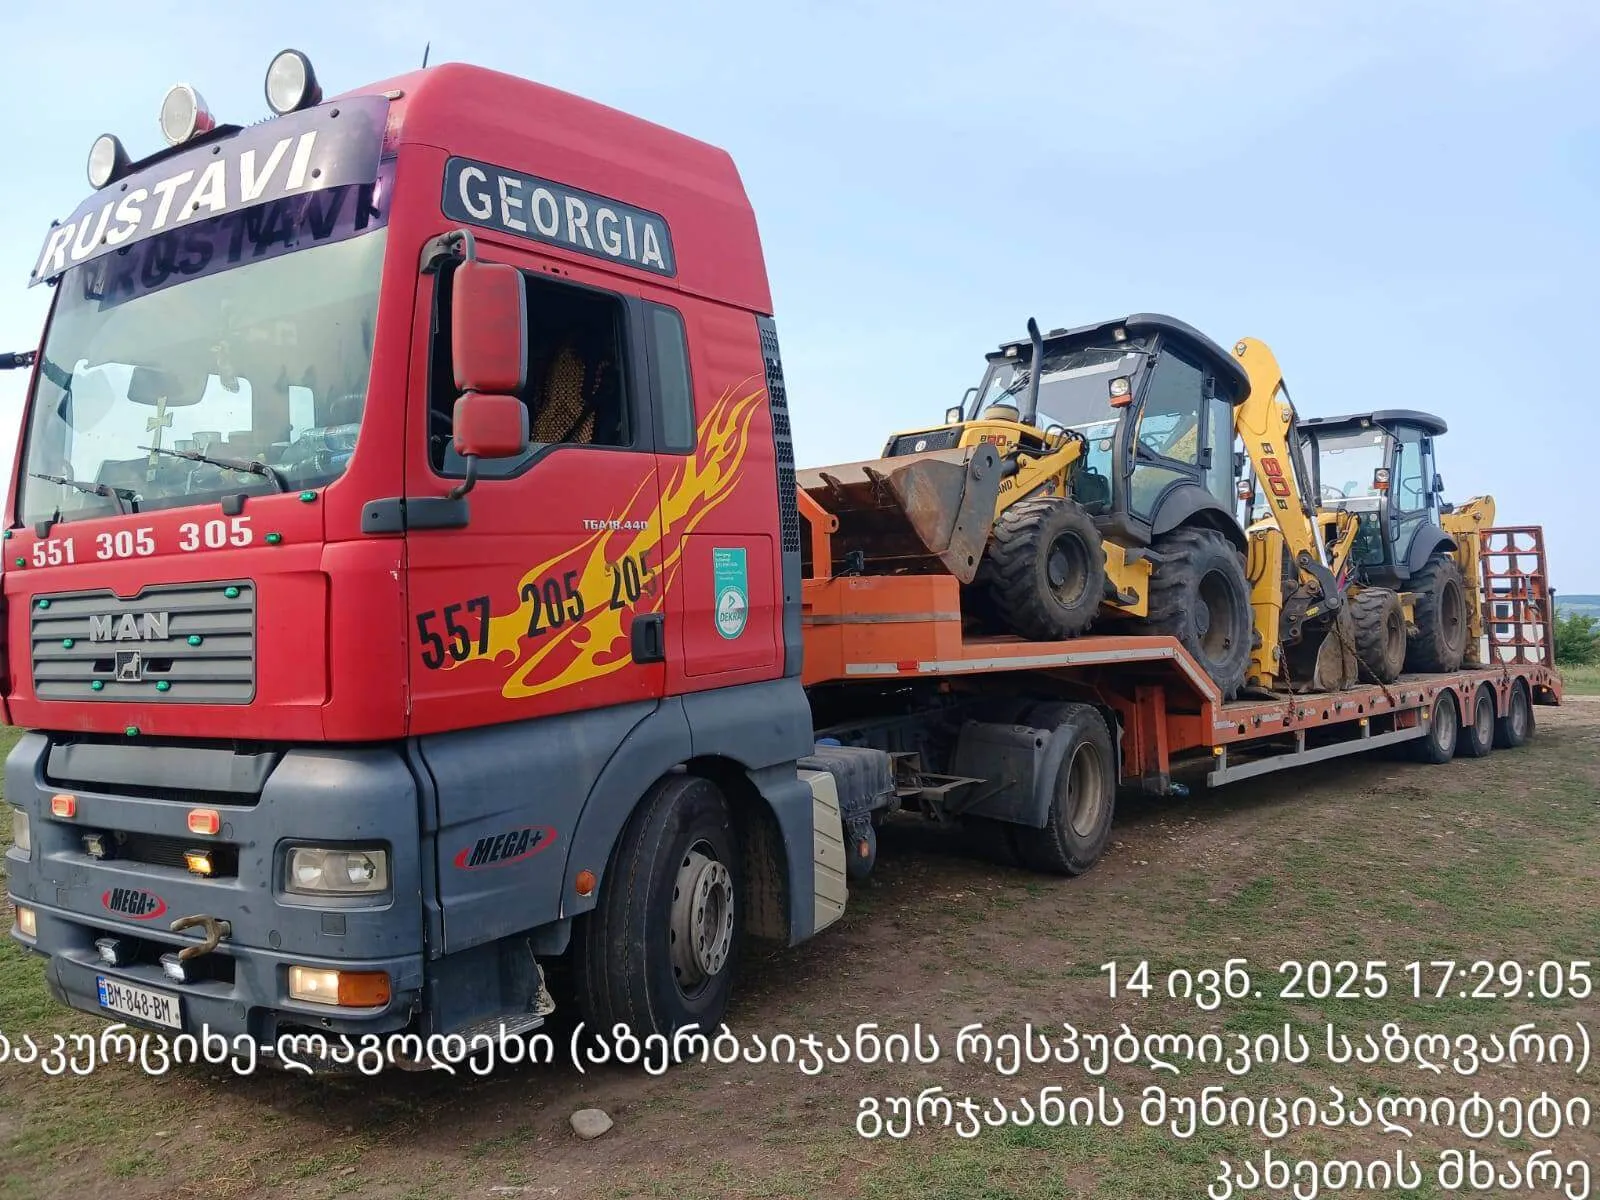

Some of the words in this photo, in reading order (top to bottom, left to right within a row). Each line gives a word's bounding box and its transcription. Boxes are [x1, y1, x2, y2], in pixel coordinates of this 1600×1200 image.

[37, 131, 318, 280] RUSTAVI
[459, 167, 666, 270] GEORGIA
[32, 537, 75, 567] 551
[96, 527, 155, 559] 305
[179, 516, 253, 552] 305
[89, 611, 169, 642] MAN
[416, 595, 490, 670] 557
[521, 570, 585, 638] 205
[604, 549, 658, 611] 205
[719, 611, 744, 622] DEKRA
[468, 829, 542, 867] MEGA+
[110, 888, 155, 915] MEGA+
[106, 983, 171, 1023] BM-848-BM
